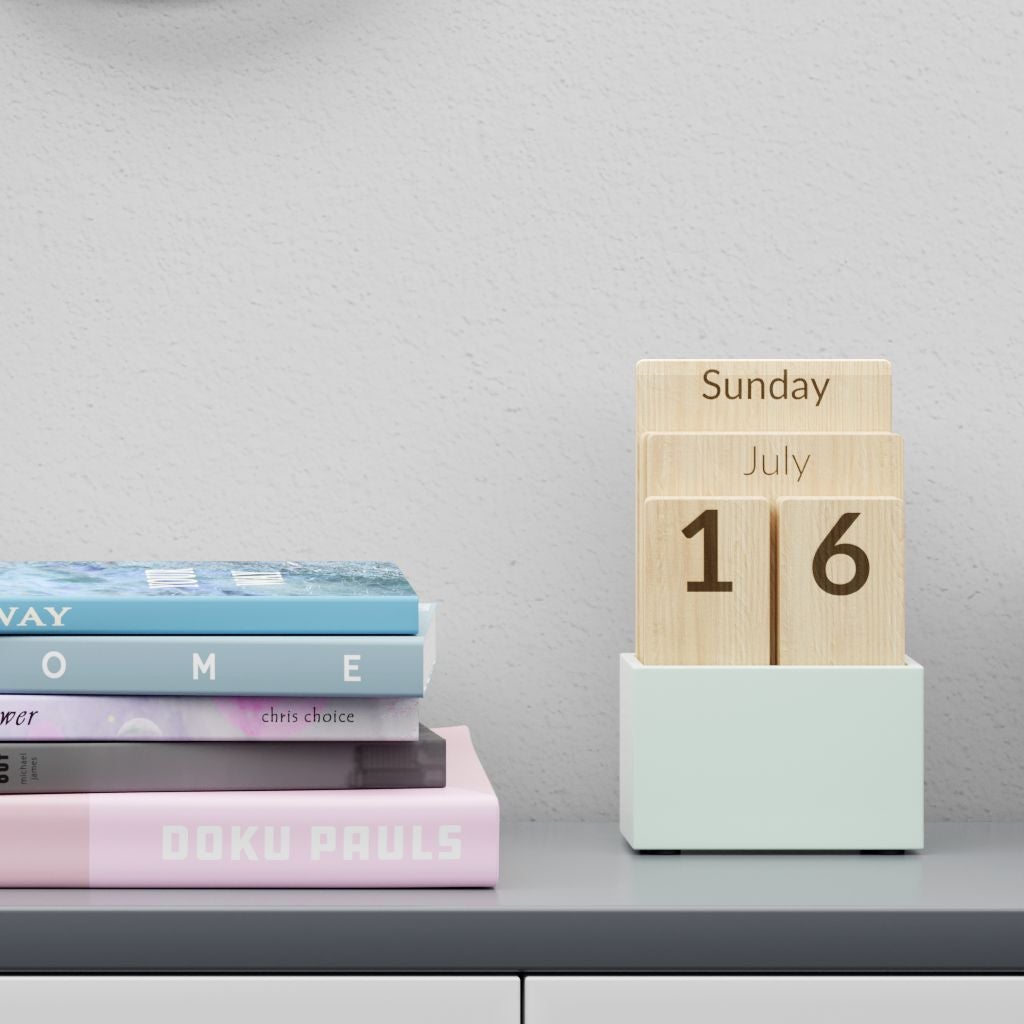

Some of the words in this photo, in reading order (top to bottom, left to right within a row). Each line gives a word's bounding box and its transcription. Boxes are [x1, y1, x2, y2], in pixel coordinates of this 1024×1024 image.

[702, 369, 830, 407] Sunday
[743, 445, 811, 482] July
[261, 706, 298, 723] chris
[304, 706, 355, 723] choice
[18, 751, 29, 785] michael
[31, 756, 40, 781] james
[161, 825, 291, 861] DOKU
[310, 825, 462, 861] PAULS
